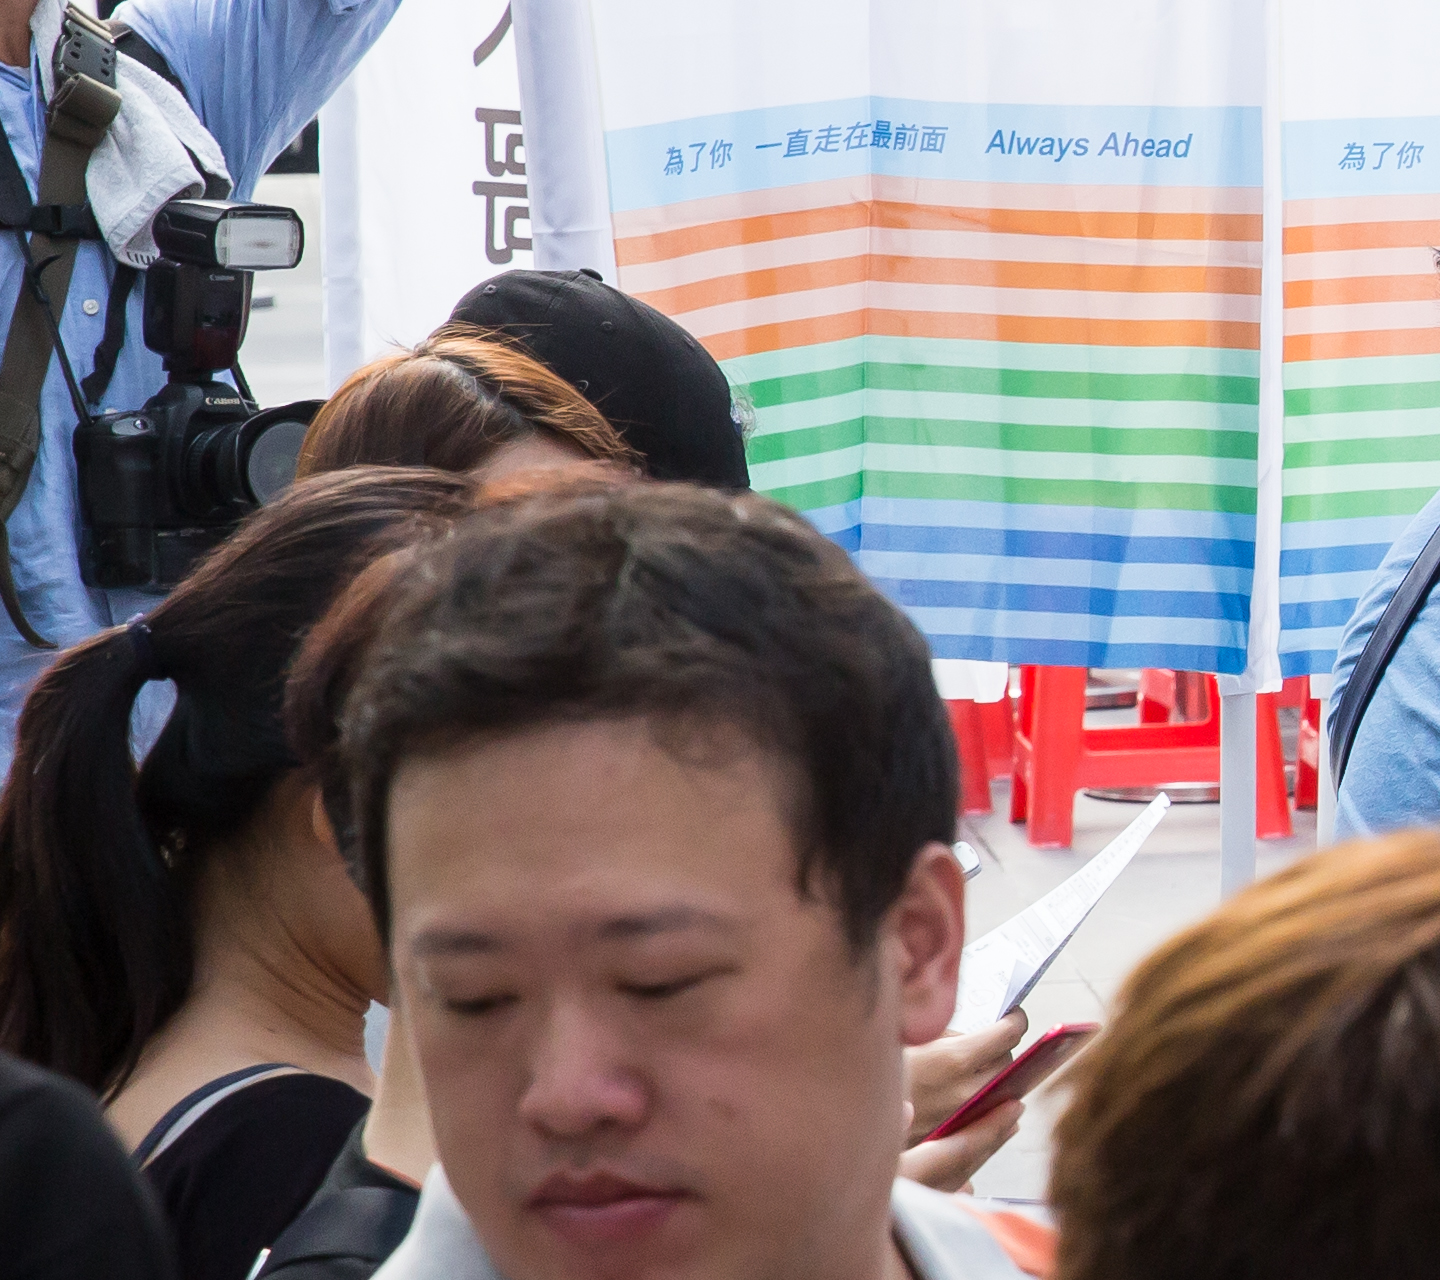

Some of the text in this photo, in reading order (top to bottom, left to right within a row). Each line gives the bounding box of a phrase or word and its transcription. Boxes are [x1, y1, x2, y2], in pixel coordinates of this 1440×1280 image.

[664, 120, 1193, 176] 為了你 一直走在最前面 Always Ahead
[1338, 141, 1424, 170] 為了你
